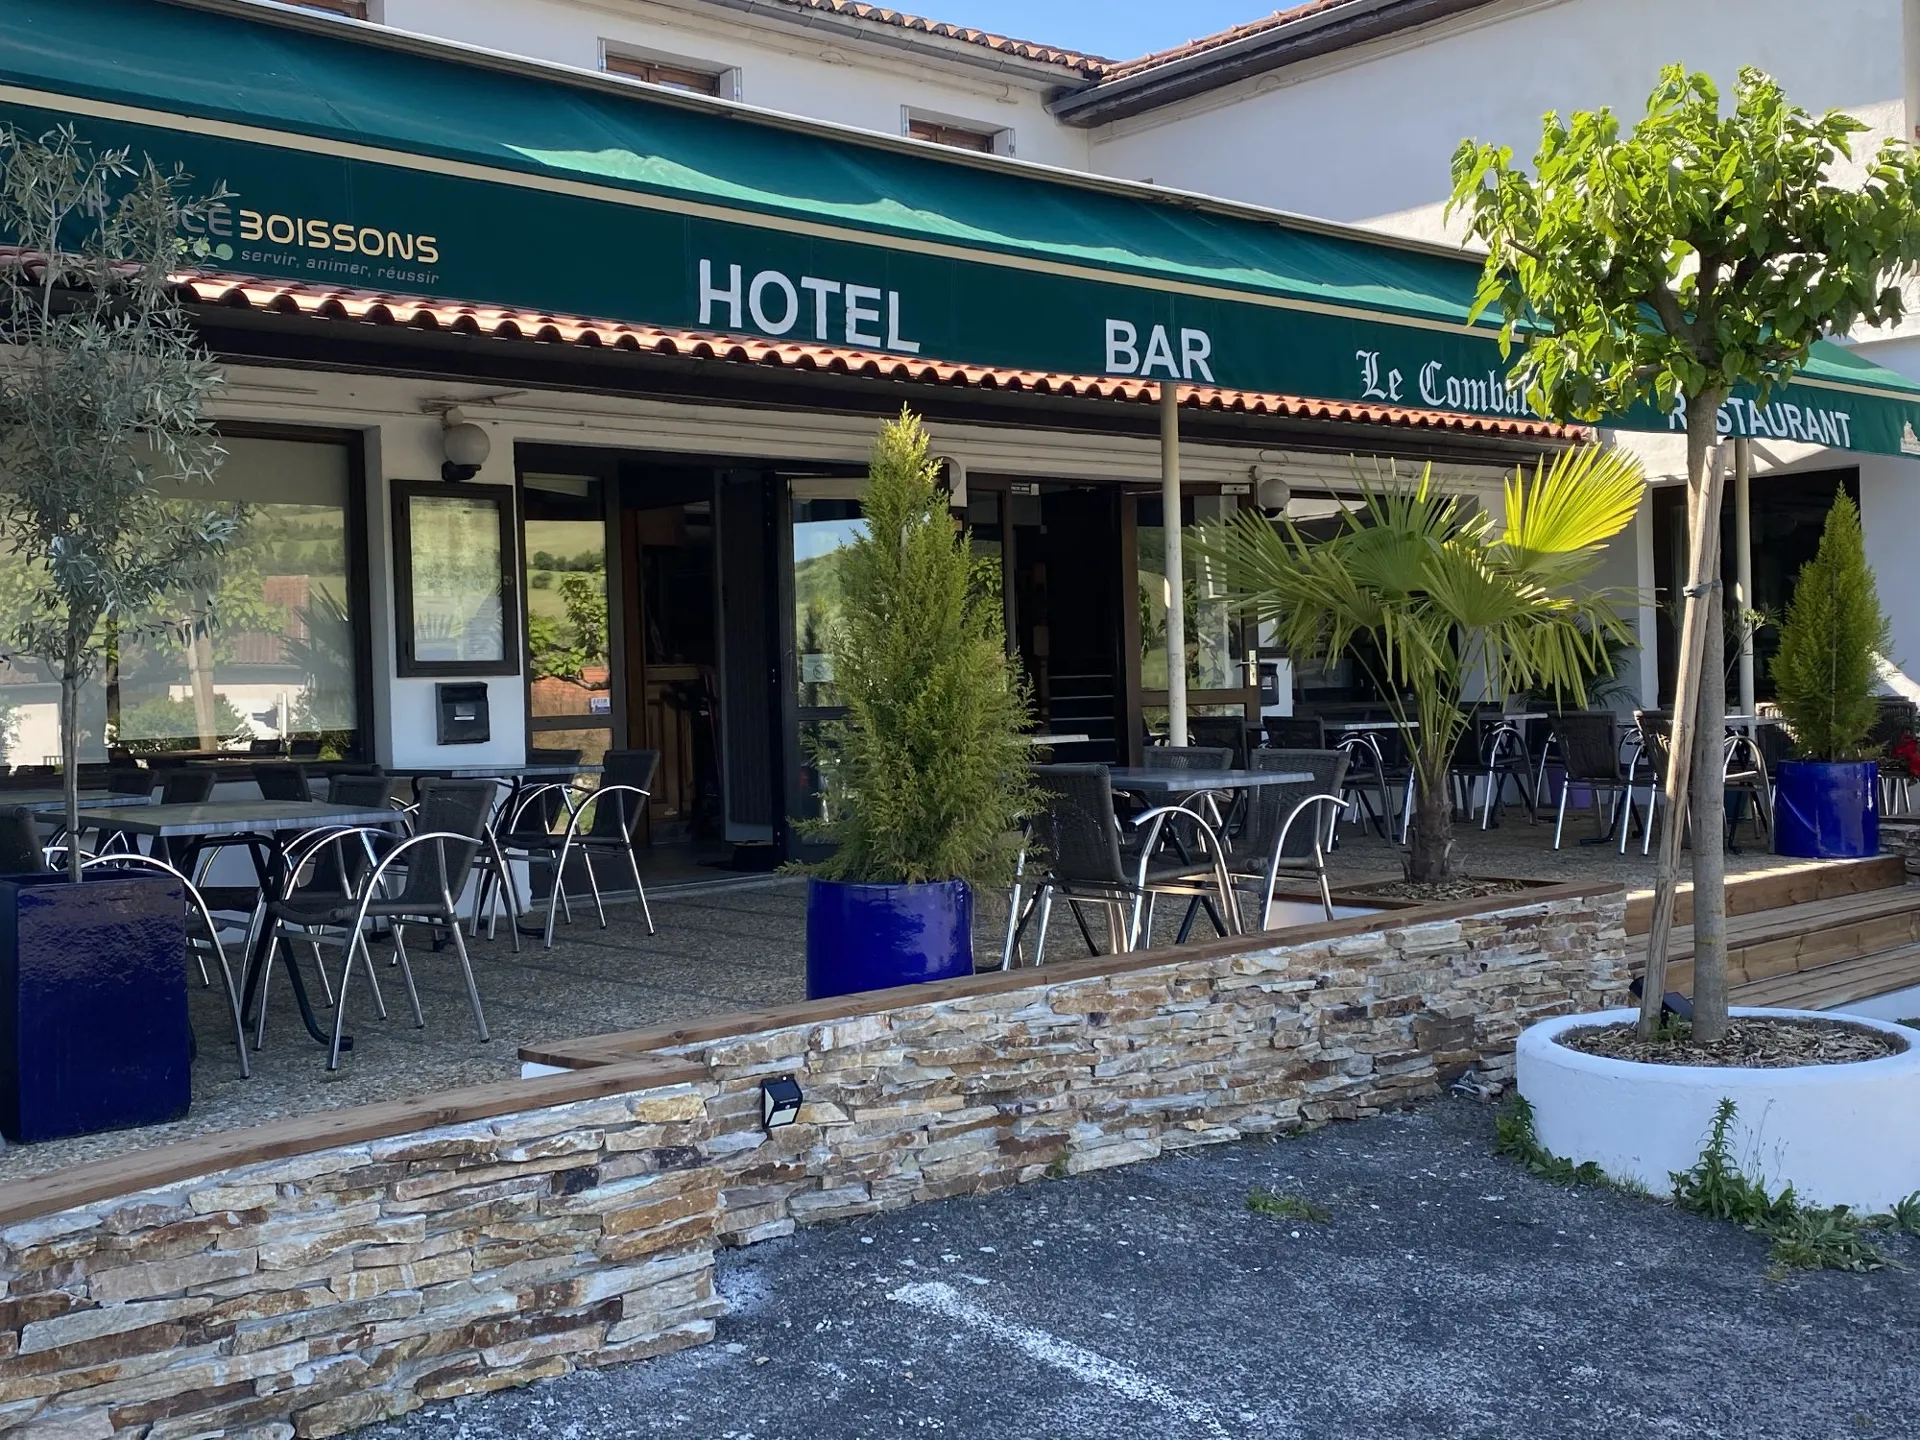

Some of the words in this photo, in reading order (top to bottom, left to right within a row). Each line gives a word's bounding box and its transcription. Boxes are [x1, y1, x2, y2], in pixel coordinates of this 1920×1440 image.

[239, 209, 440, 264] BOISSONS
[241, 249, 300, 269] servir,
[306, 257, 372, 278] animer,
[377, 266, 440, 285] réussir
[699, 258, 920, 353] HOTEL
[1104, 318, 1213, 382] BAR
[1355, 350, 1403, 402] Le
[1419, 360, 1543, 418] Combal
[1668, 391, 1851, 448] RSTAURANT
